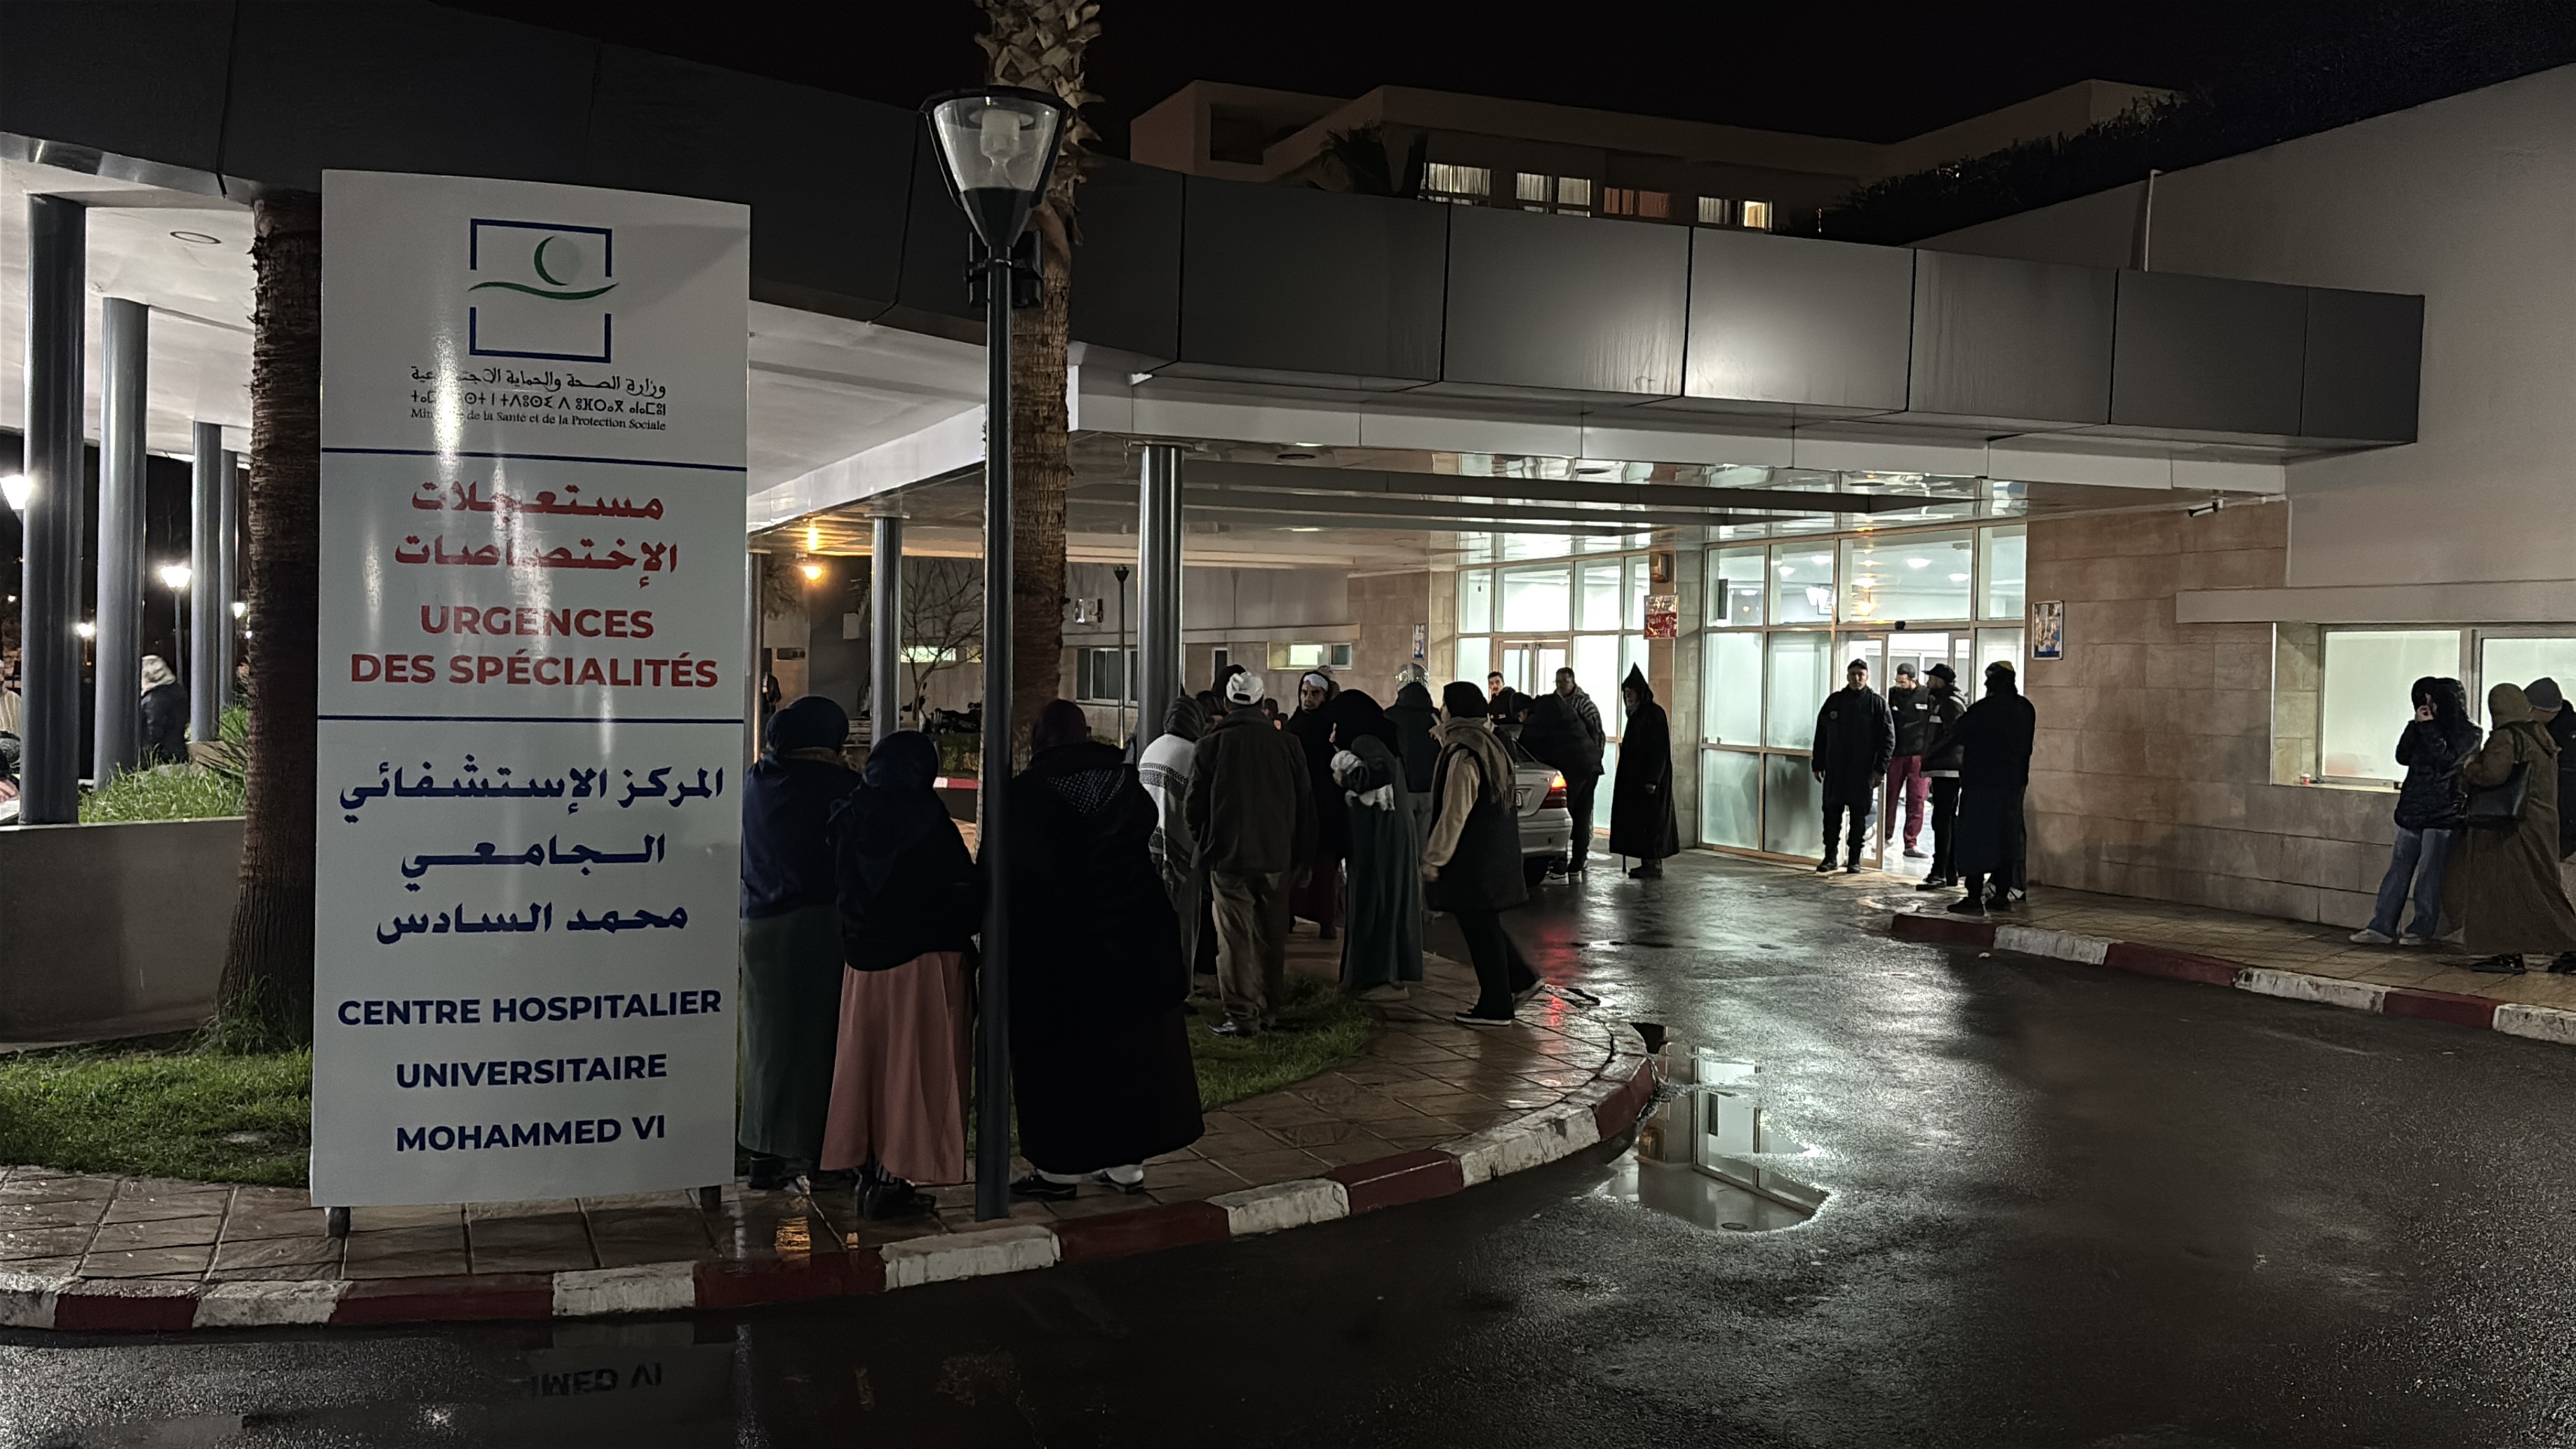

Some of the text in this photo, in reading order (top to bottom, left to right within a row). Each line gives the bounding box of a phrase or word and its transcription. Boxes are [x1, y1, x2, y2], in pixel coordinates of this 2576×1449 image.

[507, 370, 561, 392] والحماية
[567, 374, 619, 389] الصحة
[626, 379, 665, 399] وزارة
[467, 410, 480, 419] de
[484, 411, 492, 421] la
[497, 412, 525, 422] Santé
[530, 415, 538, 423] et
[542, 415, 555, 424] de
[559, 415, 568, 424] la
[572, 415, 626, 428] Protection
[629, 419, 665, 430] Sociale
[412, 481, 664, 523] مستعجلات
[395, 535, 678, 589] الإختصاصات
[422, 605, 653, 638] URGENCES
[351, 649, 718, 687] DES SPÉCIALITÉS
[340, 755, 723, 823] المركز الإستشفائي
[401, 833, 665, 891] الجامعي
[377, 902, 687, 944] محمد السادس
[338, 990, 720, 1025] CENTRE HOSPITALIER
[397, 1054, 666, 1088] UNIVERSITAIRE
[397, 1115, 664, 1151] MOHAMMED VI
